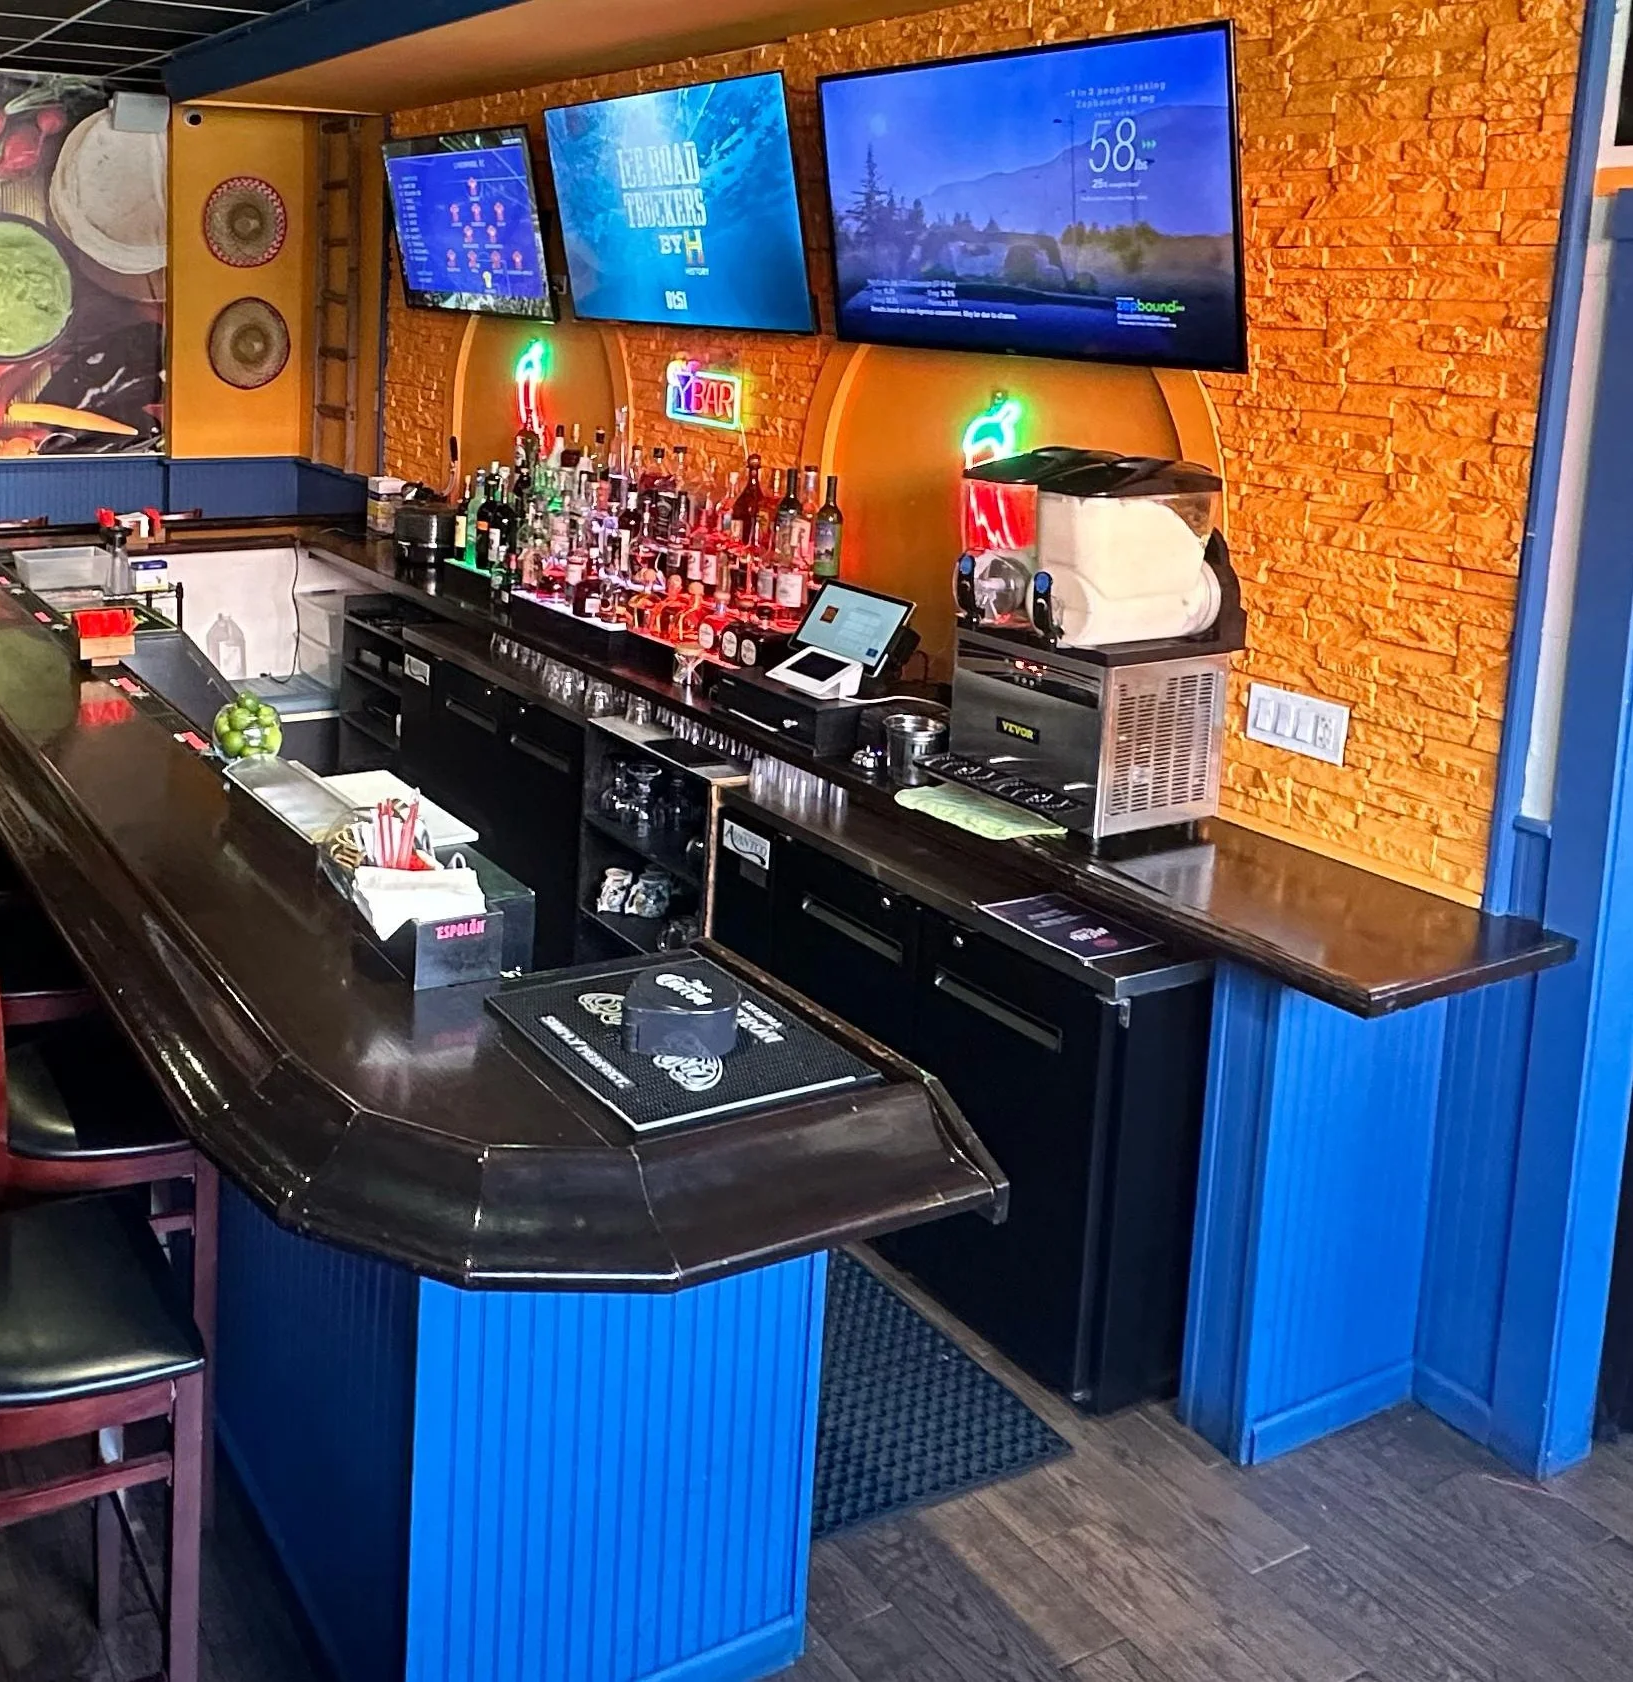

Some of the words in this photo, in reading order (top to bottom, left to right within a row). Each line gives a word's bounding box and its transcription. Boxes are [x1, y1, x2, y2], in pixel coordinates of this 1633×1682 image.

[617, 147, 647, 189] ICE
[647, 141, 701, 188] ROAD
[1088, 117, 1136, 173] 58
[623, 188, 707, 229] TRUCKERS
[658, 234, 683, 255] BY
[1001, 720, 1034, 740] VEVOR
